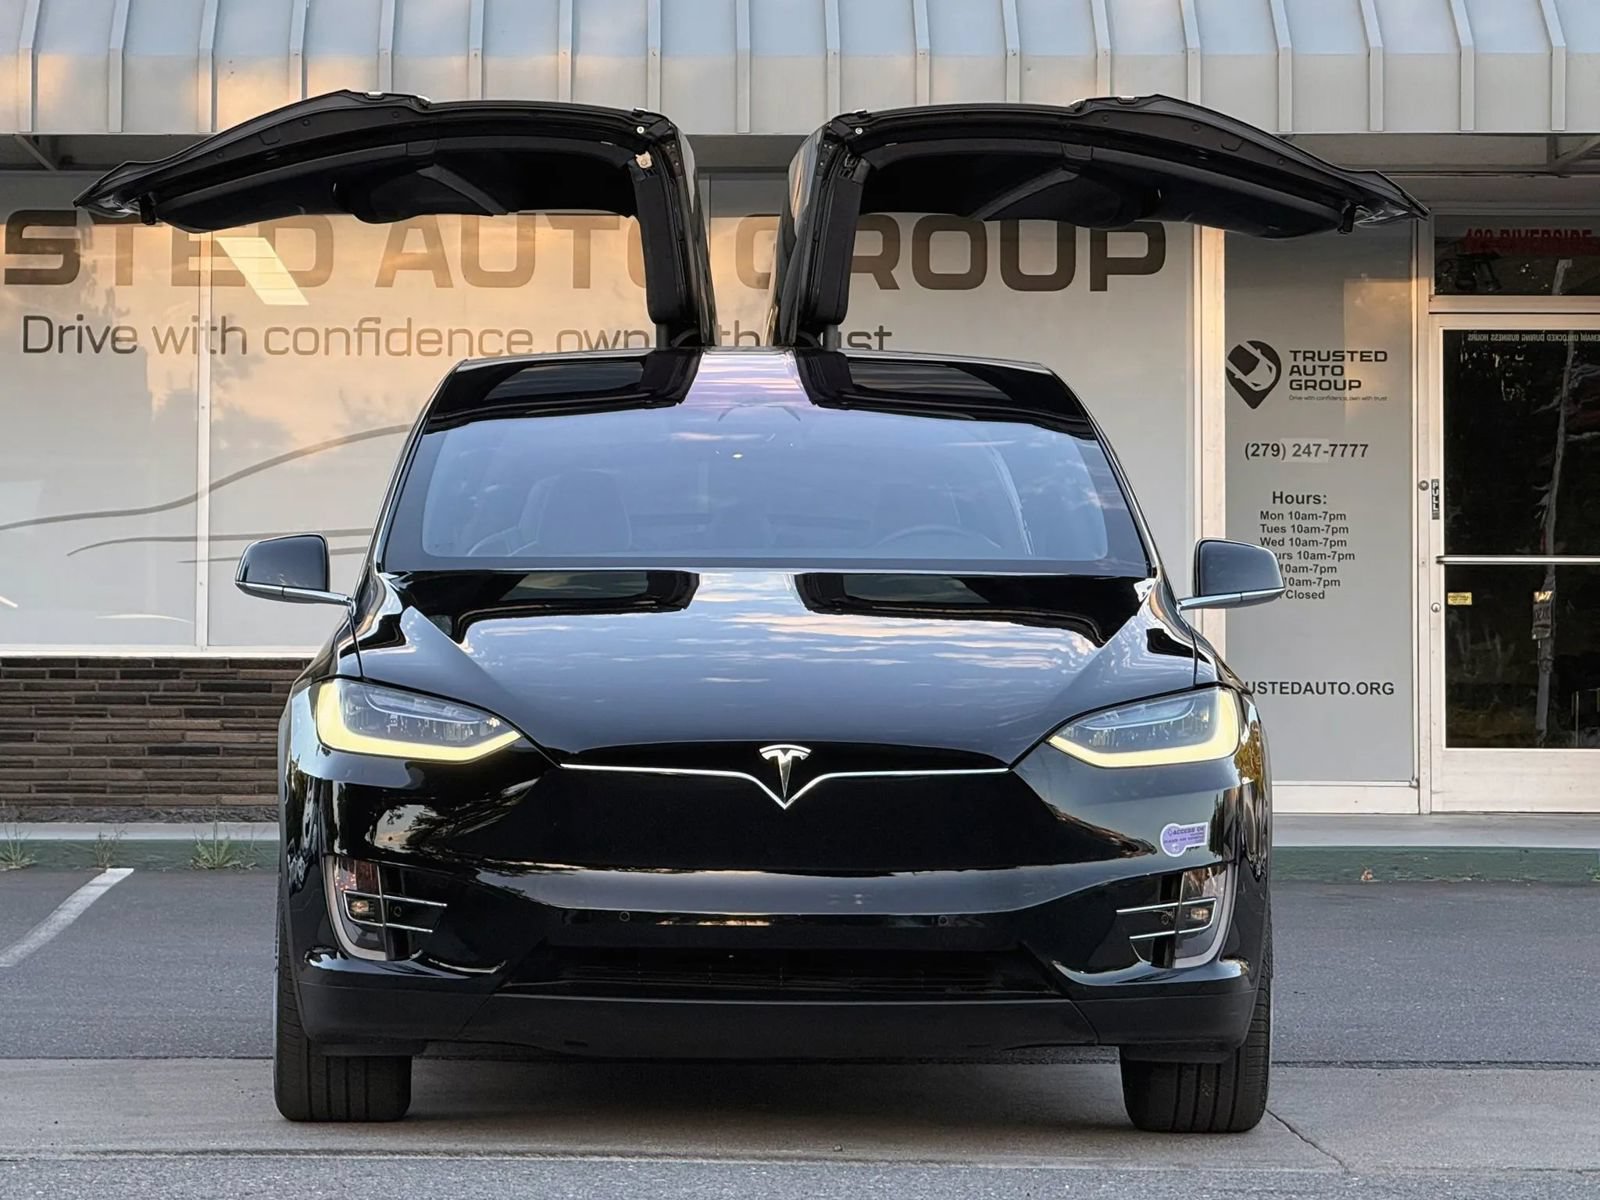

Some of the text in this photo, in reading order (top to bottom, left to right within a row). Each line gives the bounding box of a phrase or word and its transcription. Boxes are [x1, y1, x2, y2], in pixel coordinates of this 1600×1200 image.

[374, 214, 646, 289] AUT
[22, 314, 138, 355] Drive
[152, 315, 248, 356] with
[1289, 350, 1388, 362] TRUSTED
[1289, 365, 1344, 376] AUTO
[1289, 379, 1361, 391] GROUP
[1245, 443, 1369, 460] (279) 247-7777
[1272, 491, 1328, 505] Hours:
[1432, 481, 1440, 511] PULL
[1260, 511, 1347, 523] Mon 10am-7pm
[1260, 524, 1349, 536] Tues 10am-7pm
[1260, 537, 1347, 549] Wed 10am-7pm
[1275, 551, 1356, 562] urs 10am-7pm
[1285, 590, 1325, 600] Closed
[1246, 681, 1395, 695] USTEDAUTO.ORG
